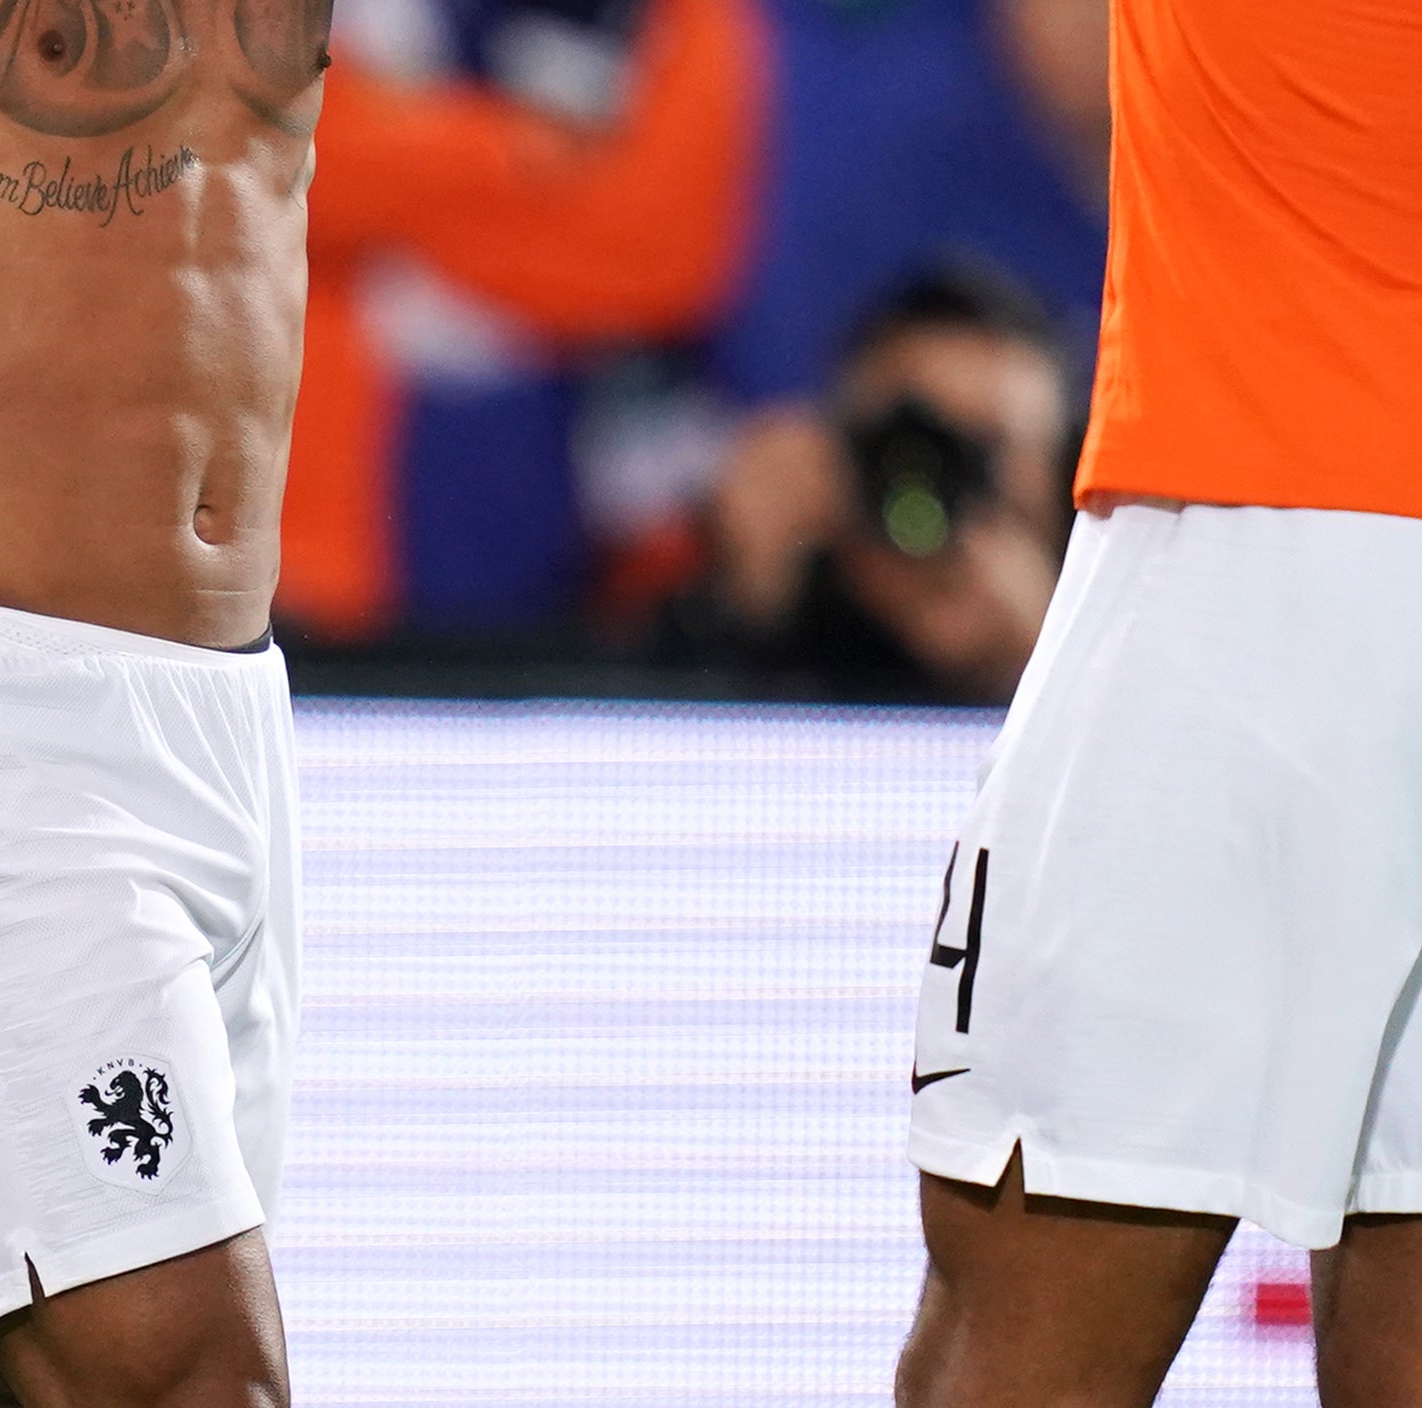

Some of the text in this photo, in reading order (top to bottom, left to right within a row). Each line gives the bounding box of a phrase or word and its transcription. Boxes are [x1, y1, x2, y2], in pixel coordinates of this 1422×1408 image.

[18, 156, 111, 216] Believe
[929, 840, 990, 1034] 4
[96, 1058, 136, 1076] KNVB
